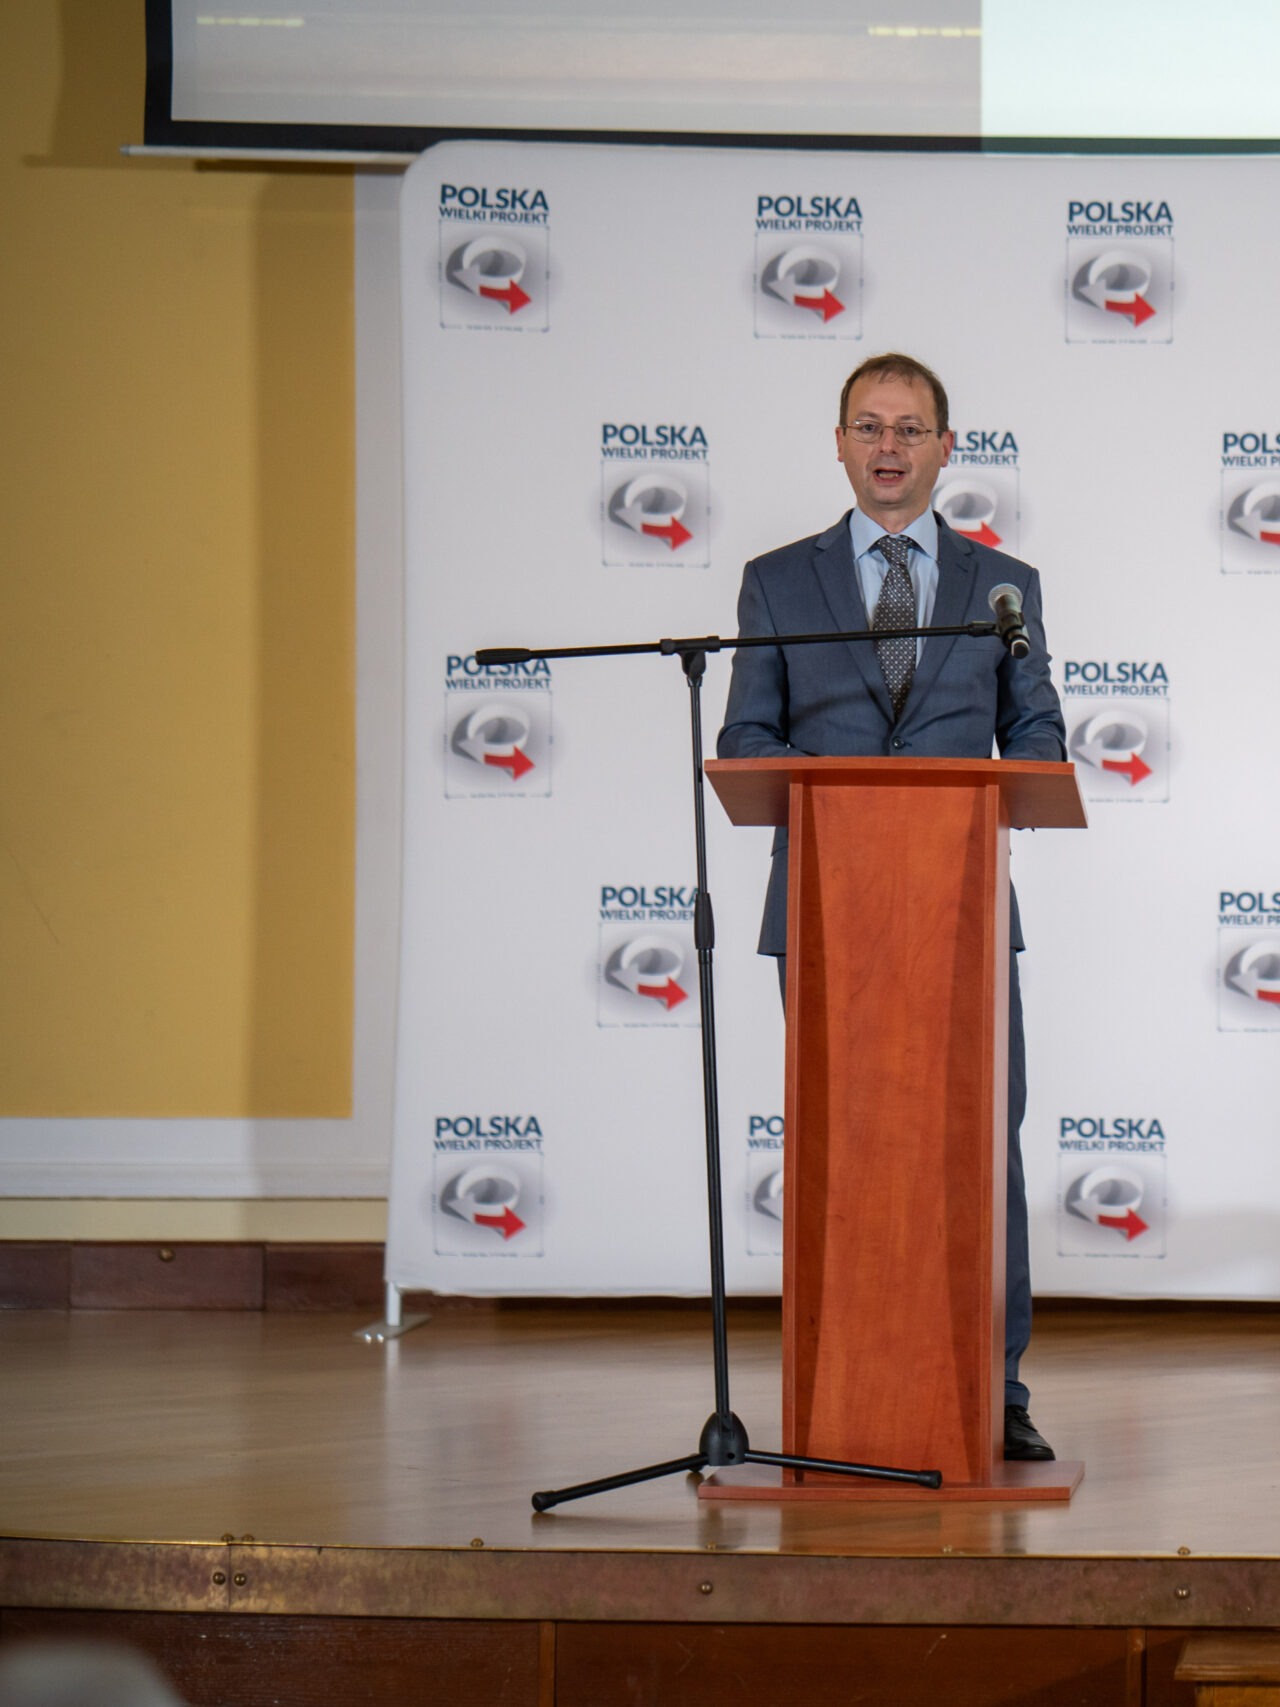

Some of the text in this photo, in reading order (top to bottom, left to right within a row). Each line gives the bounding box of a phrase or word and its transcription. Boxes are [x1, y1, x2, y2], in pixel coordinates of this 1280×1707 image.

[440, 184, 549, 211] POLSKA
[757, 196, 863, 219] POLSKA
[1068, 201, 1173, 222] POLSKA
[439, 206, 549, 224] WIELKI PROJEKT
[755, 219, 862, 232] WIELKI PROJEKT
[1067, 224, 1173, 236] WIELKI PROJEKT
[602, 424, 708, 447] POLSKA
[953, 431, 1018, 452] LSKA
[600, 447, 708, 460] WIELKI PROJEKT
[961, 454, 1018, 465] PROJEKT
[1222, 456, 1267, 466] WIELKI
[1064, 661, 1169, 683] POLSKA
[445, 678, 551, 689] WIELKI PROJEKT
[1063, 684, 1169, 696] WIELKI PROJEKT
[599, 909, 696, 920] WIELKI PROJE
[1218, 915, 1263, 925] WIELKI
[435, 1116, 542, 1138] POLSKA
[1060, 1117, 1165, 1139] POLSKA
[433, 1138, 542, 1151] WIELKI PROJEKT
[747, 1139, 784, 1149] WIEL
[1058, 1140, 1165, 1152] WIELKI PROJEKT
